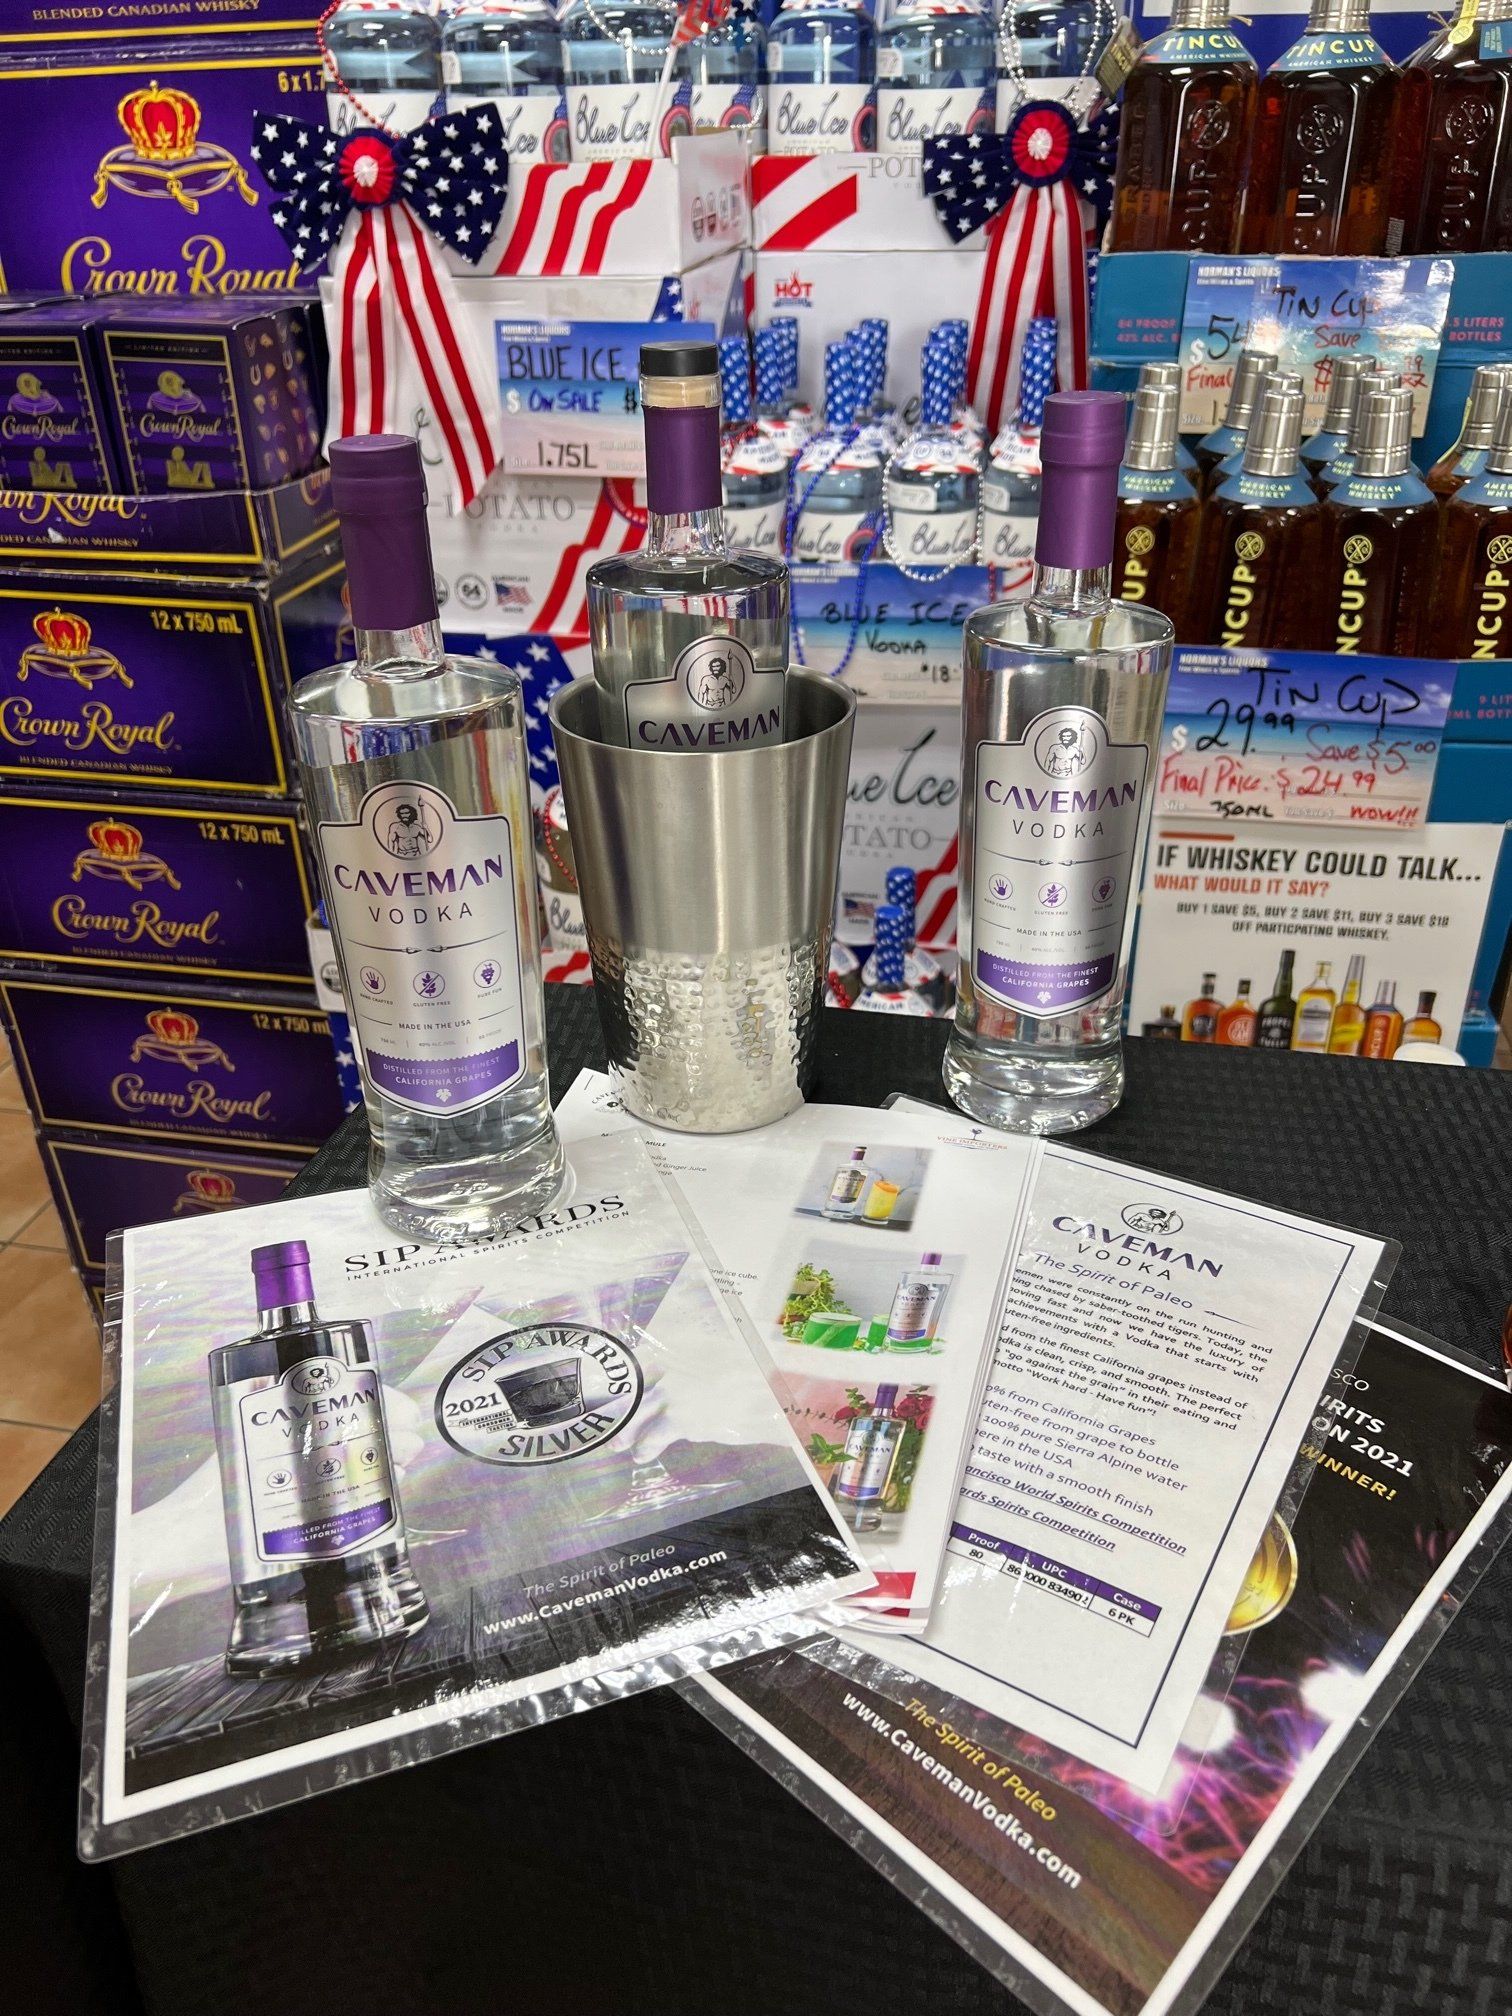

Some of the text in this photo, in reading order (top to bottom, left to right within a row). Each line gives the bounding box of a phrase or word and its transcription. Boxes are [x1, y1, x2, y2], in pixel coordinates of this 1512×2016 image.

[33, 0, 260, 20] BLENDED CANADIAN WHISKY
[1287, 39, 1376, 58] TINCUP
[1288, 56, 1372, 67] AMERICAN WHISKEY
[776, 90, 849, 143] Blue Ice
[60, 236, 180, 295] Crown
[1197, 266, 1241, 278] NORMAN'S
[774, 273, 814, 297] HOT
[1314, 326, 1361, 350] Save
[1448, 331, 1502, 343] BOTTLES
[1465, 318, 1504, 328] LITERS
[507, 345, 625, 381] BLUE ICE
[1186, 364, 1234, 391] Final
[555, 390, 603, 413] SALE
[537, 441, 597, 470] 1.75L
[151, 610, 243, 633] 12 x 750 mL
[821, 602, 968, 627] BLUE ICE
[0, 696, 175, 754] Crown Royal
[639, 706, 779, 746] CAVEMAN
[1306, 723, 1360, 761] Save
[1160, 752, 1207, 796] Final
[984, 780, 1137, 813] CAVEMAN
[1013, 819, 1103, 838] VODKA
[334, 854, 503, 897] CAVEMAN
[1157, 845, 1482, 882] IF WHISKEY COULD TALK...
[1154, 873, 1330, 897] WHAT WOULD IT SAY?
[52, 894, 220, 948] Crown Royal
[369, 902, 473, 924] VODKA
[1177, 903, 1200, 914] BUY
[1203, 903, 1208, 914] 1
[1212, 904, 1239, 916] SAVE
[1264, 906, 1288, 918] BUY
[1291, 907, 1298, 919] 2
[1302, 908, 1329, 920] SAVE
[1359, 911, 1383, 923] BUY
[1397, 913, 1425, 926] SAVE
[1232, 922, 1252, 932] OFF
[1337, 926, 1390, 940] WHISKEY.
[1017, 928, 1037, 937] MADE
[992, 963, 1029, 978] DISTILLED
[1031, 971, 1055, 979] FROM
[1073, 967, 1099, 977] FINEST
[1002, 977, 1090, 988] CALIFORNIA GRAPES
[395, 1070, 492, 1086] CALIFORNIA GRAPES
[663, 1163, 687, 1171] Ginger
[344, 1244, 420, 1272] SIP
[347, 1210, 630, 1281] INTERNATIONAL SPIRITS COMPETITION
[1052, 1216, 1223, 1278] CAVEMAN
[1078, 1243, 1171, 1281] VODKA
[1034, 1253, 1193, 1310] The Spirit of Paleo
[1034, 1284, 1268, 1363] chased by saber-toothed tigers. Today, the
[461, 1330, 632, 1395] SIP AWARDS
[251, 1388, 376, 1427] CAVEMAN
[445, 1393, 502, 1417] 2021
[459, 1409, 510, 1427] INTERNATIONAL
[1008, 1390, 1157, 1449] from California Grapes
[475, 1417, 511, 1430] CONSUMER
[487, 1422, 516, 1433] TASTING
[499, 1411, 616, 1458] SILVER
[983, 1415, 1188, 1492] 100% pure Sierra Alpine water
[1042, 1417, 1180, 1472] from grape to bottle
[1351, 1436, 1413, 1477] 2021
[977, 1446, 1154, 1517] taste with a smooth finish
[1299, 1445, 1399, 1501] WINNER!
[1013, 1480, 1188, 1555] World Spirits Competition
[522, 1544, 676, 1599] The Spirit of Paleo
[968, 1532, 1142, 1612] Proof UPC Case
[968, 1549, 1135, 1626] 80 6 PK
[483, 1550, 728, 1635] www.CavemanVodka.com
[904, 1698, 1056, 1821] The Spirit of Paleo
[842, 1692, 1082, 1889] www.CavemanVodka.com
